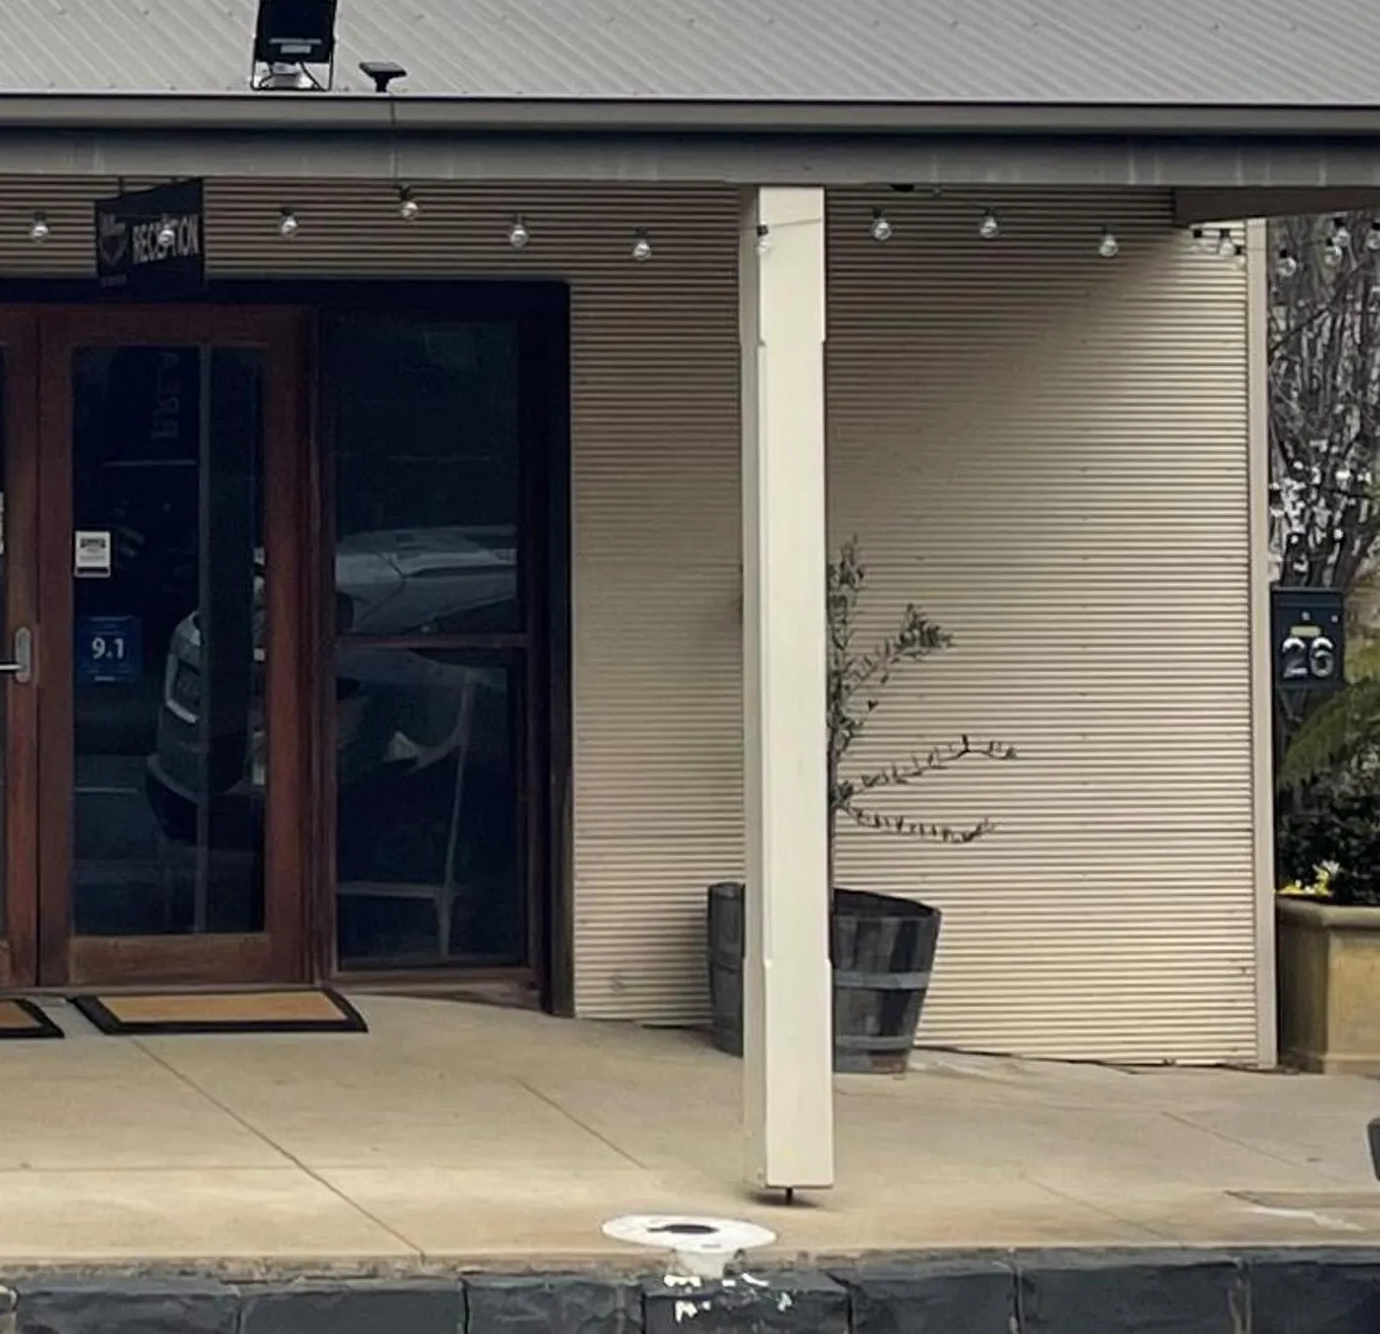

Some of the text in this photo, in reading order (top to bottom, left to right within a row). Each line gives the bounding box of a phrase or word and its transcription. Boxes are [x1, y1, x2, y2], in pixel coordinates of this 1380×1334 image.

[132, 214, 198, 264] RECETION
[91, 636, 125, 660] 9.1
[1282, 637, 1334, 678] 26
